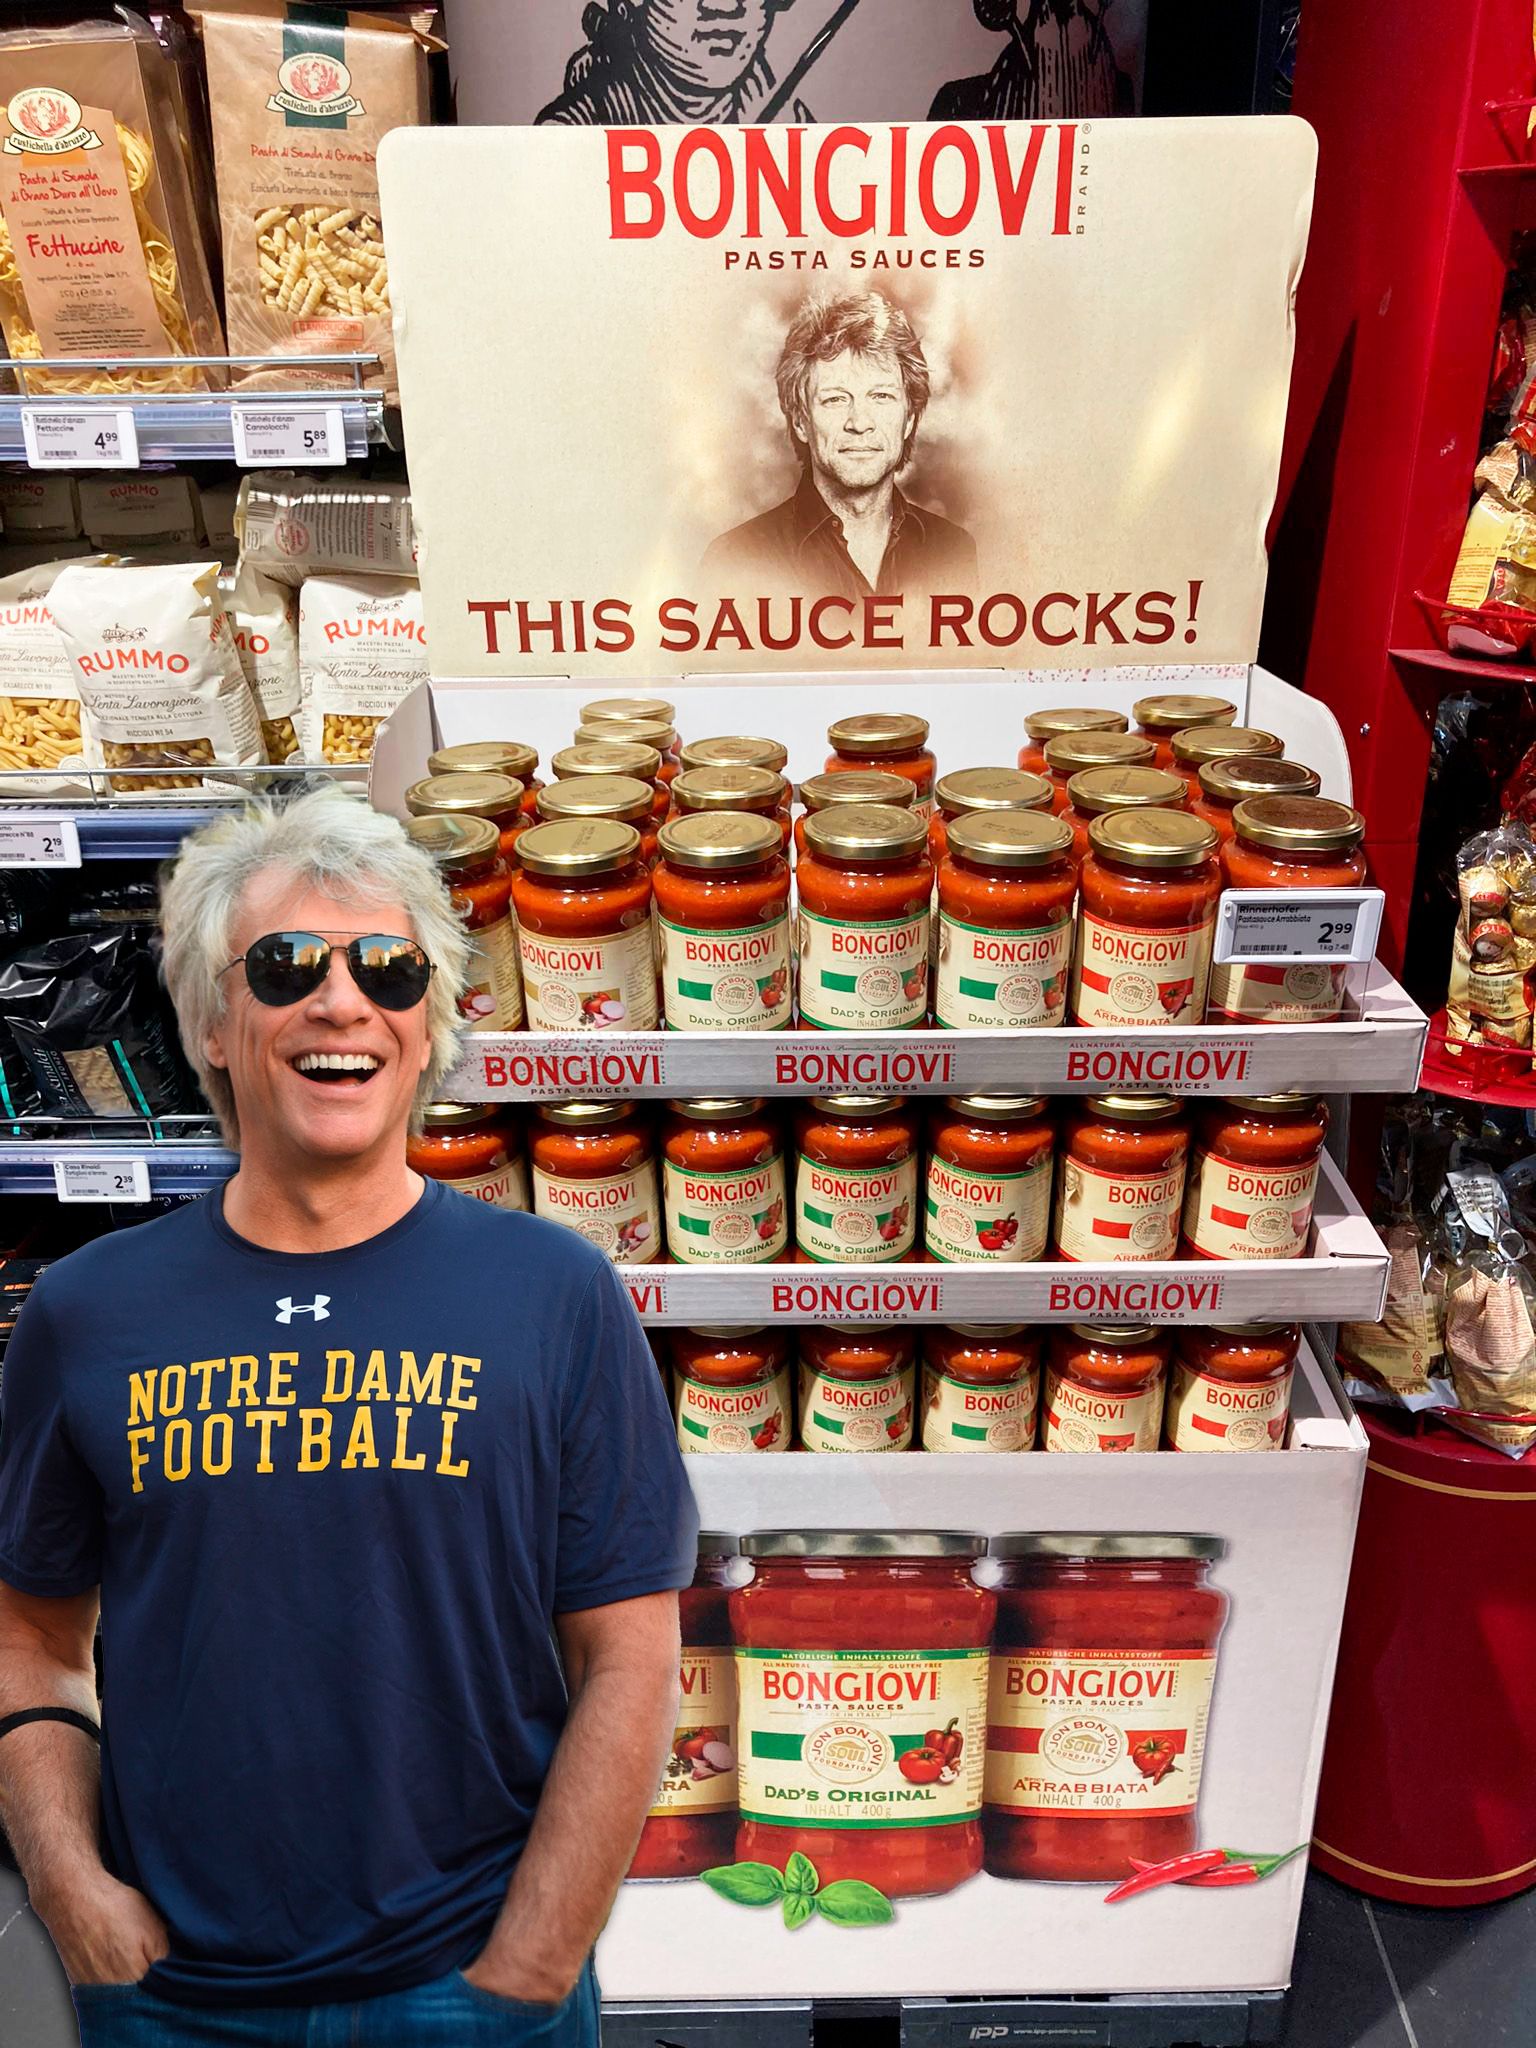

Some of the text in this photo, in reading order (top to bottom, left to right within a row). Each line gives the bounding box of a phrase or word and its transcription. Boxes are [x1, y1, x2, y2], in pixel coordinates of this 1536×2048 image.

[20, 172, 48, 185] Pasta
[604, 124, 1078, 239] BONGIOVI
[26, 234, 124, 258] Fettuccine
[725, 248, 986, 271] PASTA SAUCES
[110, 484, 159, 498] RUMMO
[467, 580, 1206, 655] THIS SAUCE ROCKS!
[77, 648, 190, 677] RUMMO
[1238, 914, 1311, 924] Pastasauce Arrabbiata
[1239, 904, 1300, 914] Rinnerhofer
[686, 934, 776, 962] BONGIOVI
[832, 926, 920, 955] BONGIOVI
[973, 934, 1064, 962] BONGIOVI
[1092, 930, 1187, 961] BONGIOVI
[521, 940, 602, 971] BONGIOVI
[689, 1009, 779, 1027] DAD'S ORIGINAL
[830, 1002, 919, 1019] DAD'S ORIGINAL
[968, 1010, 1057, 1026] DAD'S ORIGINAL
[1093, 1009, 1171, 1026] ARRABBIATA
[484, 1054, 661, 1087] BONGIOVI
[775, 1053, 951, 1084] BONGIOVI
[1067, 1050, 1248, 1081] BONGIOVI
[531, 1086, 630, 1095] PASTA SAUCES
[549, 1182, 635, 1208] BONGIOVI
[685, 1173, 771, 1202] BONGIOVI
[812, 1172, 897, 1198] BONGIOVI
[1227, 1171, 1313, 1197] BONGIOVI
[689, 1240, 775, 1259] DAD'S ORIGINAL
[811, 1236, 898, 1254] DAD'S ORIGINAL
[945, 1243, 1000, 1260] ORIGINAL
[1229, 1241, 1298, 1254] ARRABBIATA
[772, 1285, 938, 1312] BONGIOVI
[1049, 1283, 1219, 1311] BONGIOVI
[127, 1349, 483, 1427] NOTRE DAME
[823, 1380, 903, 1407] BONGIOVI
[688, 1389, 768, 1413] BONGIOVI
[126, 1405, 471, 1494] FOOTBALL
[764, 1670, 937, 1702] BONGIOVI
[1006, 1667, 1175, 1698] BONGIOVI
[848, 1703, 904, 1711] SAUCES
[1041, 1698, 1144, 1707] PASTA SAUCES
[811, 1726, 883, 1768] JON BON JOVI
[1049, 1720, 1120, 1759] JON BON JOVI
[1063, 1735, 1101, 1756] SOUL
[827, 1744, 866, 1763] SOUL
[764, 1785, 937, 1803] DAD'S ORIGINAL
[1013, 1778, 1149, 1793] ARRABBIATA
[804, 1804, 851, 1817] INHALT
[1037, 1794, 1083, 1806] INHALT
